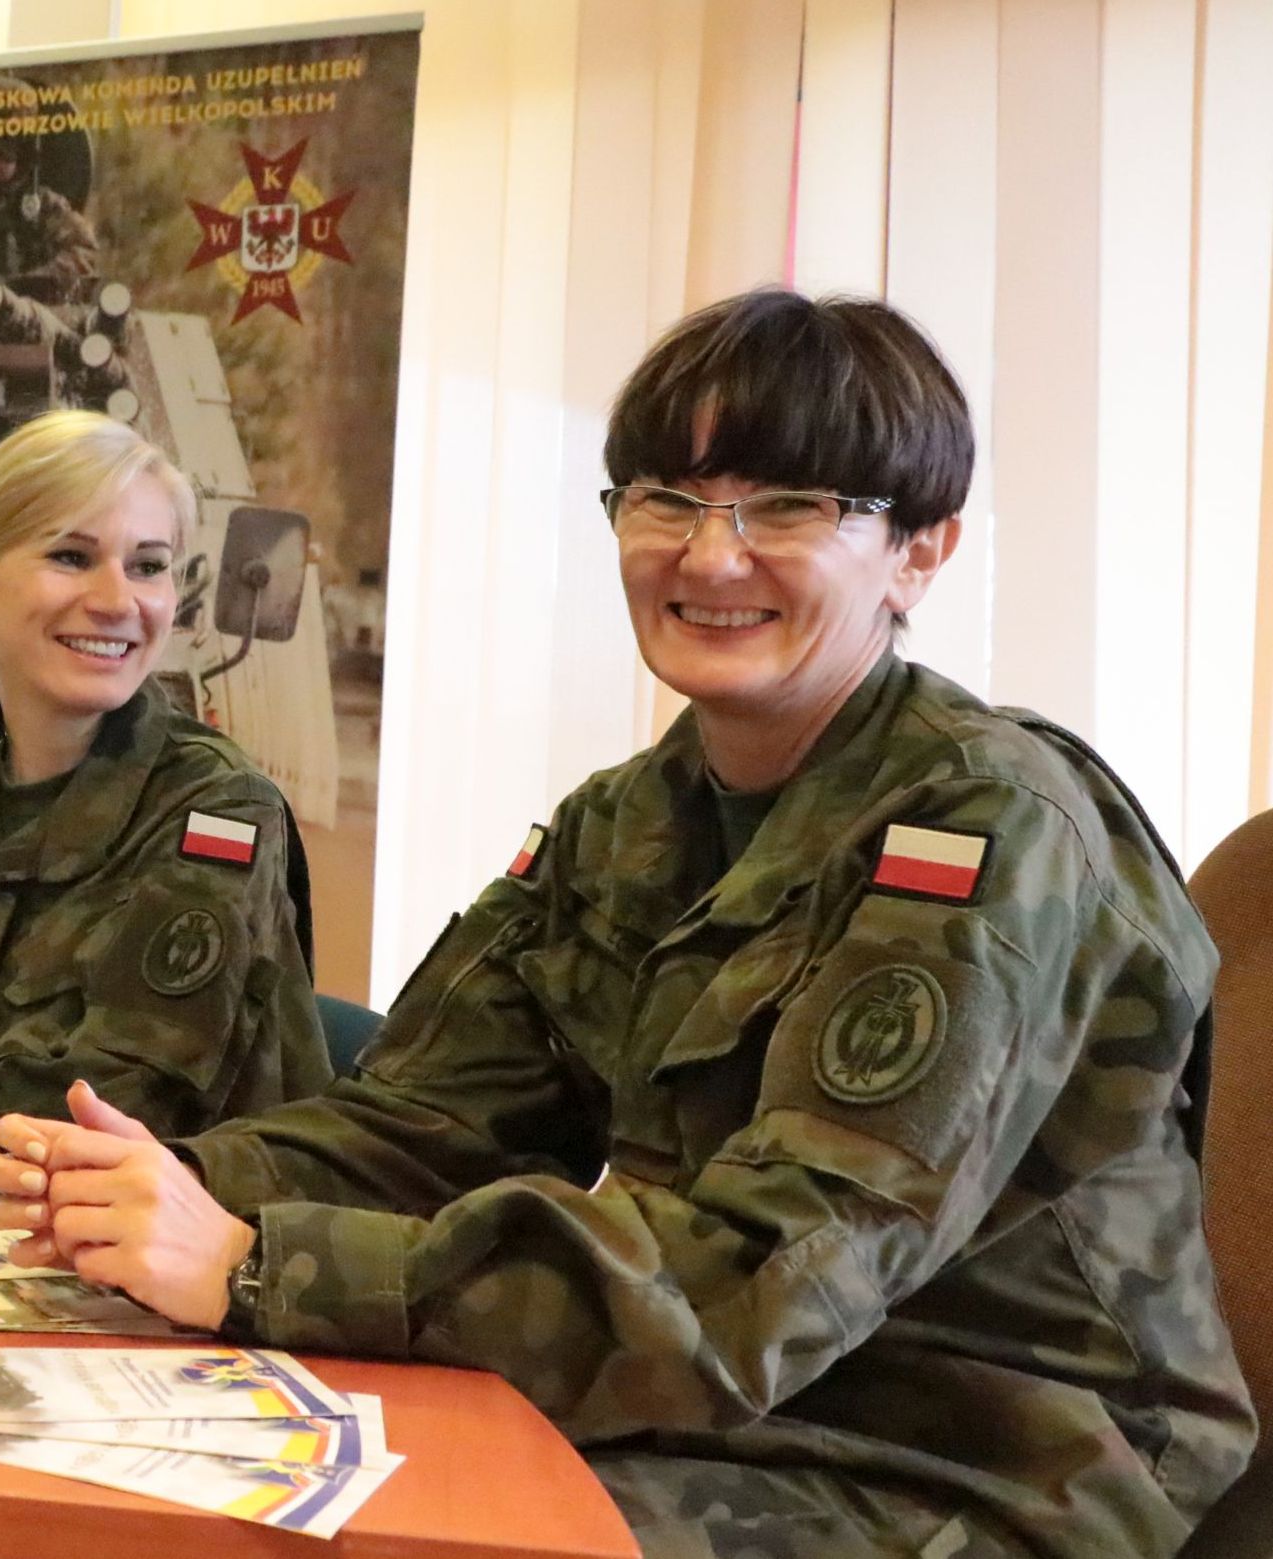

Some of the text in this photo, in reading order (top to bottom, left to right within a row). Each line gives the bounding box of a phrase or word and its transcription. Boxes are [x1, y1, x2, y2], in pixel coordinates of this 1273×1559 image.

[83, 74, 196, 101] KOMENDA
[124, 91, 336, 128] WIELKOPOLSKIM
[262, 165, 283, 190] K
[210, 217, 332, 246] W U
[252, 278, 286, 298] 1945
